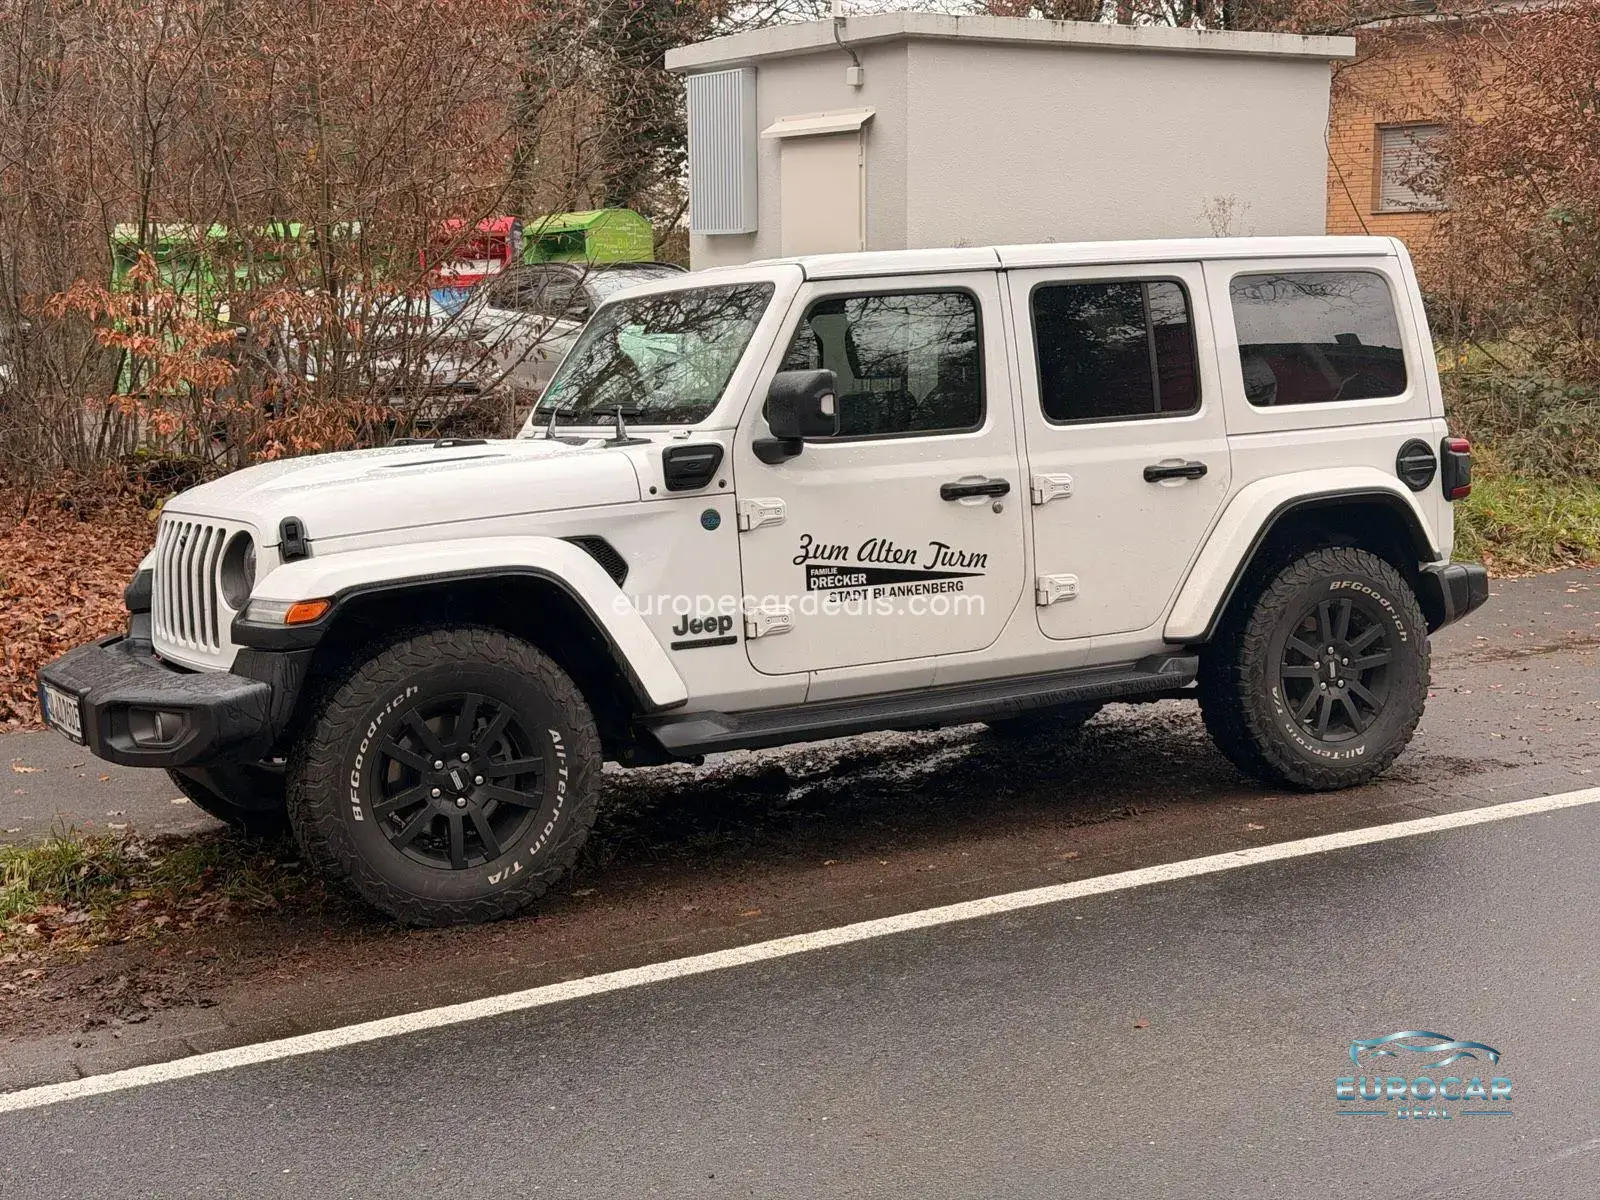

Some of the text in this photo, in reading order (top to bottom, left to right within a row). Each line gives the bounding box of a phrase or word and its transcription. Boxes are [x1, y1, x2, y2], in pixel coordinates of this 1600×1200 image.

[793, 533, 988, 570] Zum Alten Turm
[810, 567, 838, 576] FAMILIE
[810, 573, 867, 589] DRECKER
[829, 588, 869, 603] STADT
[672, 613, 733, 636] Jeep
[1329, 580, 1408, 642] BFGoodrich
[350, 685, 418, 822] BFGoodrich
[487, 728, 569, 885] All-Terrain T/A
